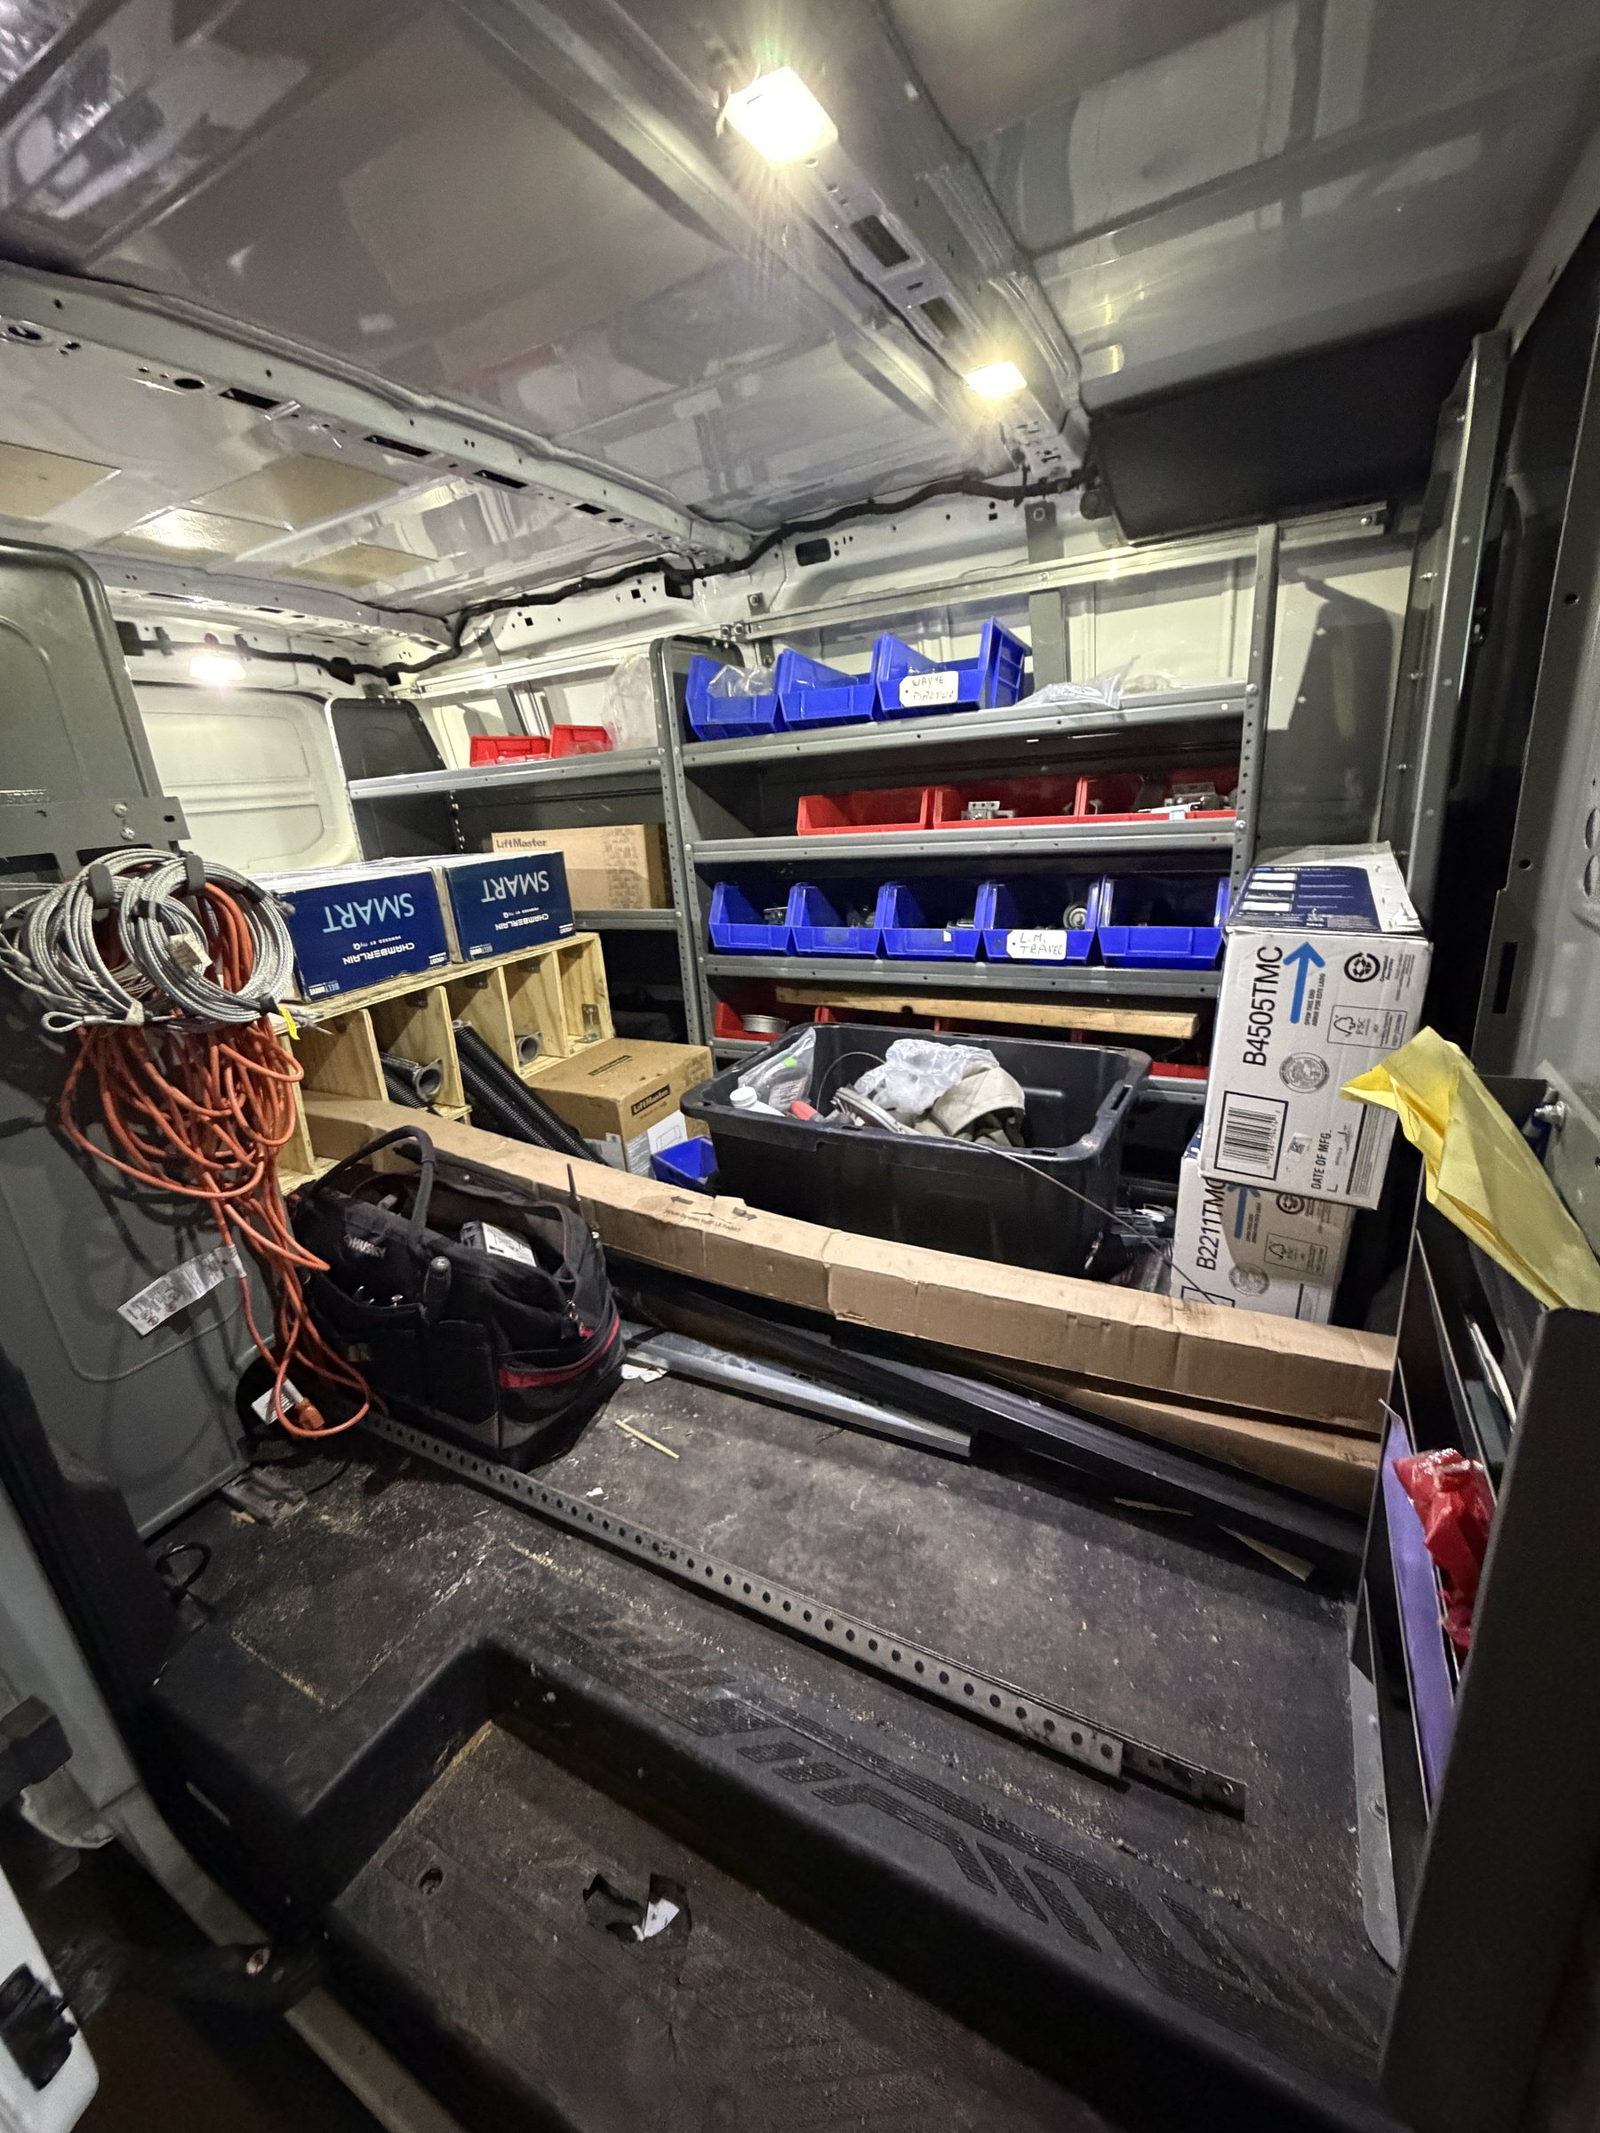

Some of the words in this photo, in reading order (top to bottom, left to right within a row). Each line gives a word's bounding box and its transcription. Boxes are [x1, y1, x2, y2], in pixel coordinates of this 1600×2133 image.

[495, 838, 547, 848] LiftMaster
[481, 870, 550, 903] SMART
[322, 892, 415, 933] SMART
[494, 913, 549, 931] CHAMBERLAIN
[342, 942, 415, 965] CHAMBERLAIN
[1242, 946, 1283, 1067] B4505TMC
[1319, 1129, 1333, 1151] MFG.
[1316, 1152, 1327, 1167] OF
[1311, 1168, 1325, 1190] DATE
